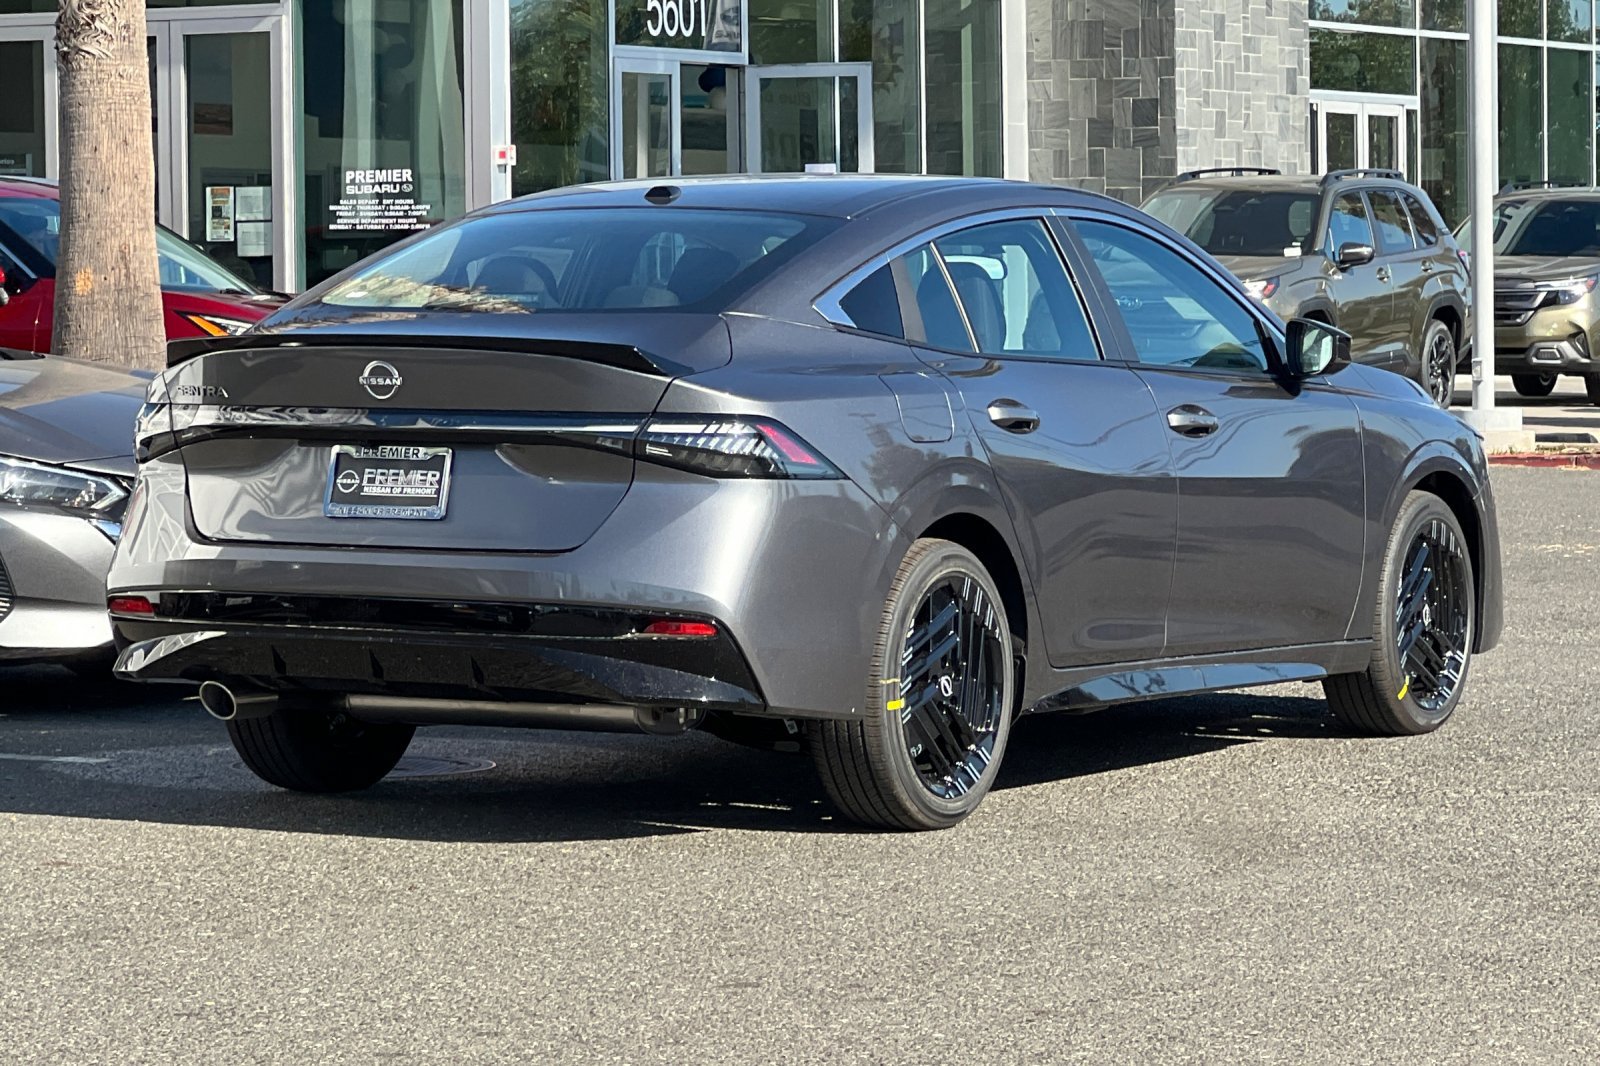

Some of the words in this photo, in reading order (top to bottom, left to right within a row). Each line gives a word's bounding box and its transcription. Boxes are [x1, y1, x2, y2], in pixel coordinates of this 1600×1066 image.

[646, 0, 706, 37] 5601
[345, 169, 413, 184] PREMIER
[345, 183, 400, 194] SUBARU
[358, 376, 402, 386] NISSAN
[176, 385, 229, 398] SENTRA
[361, 446, 420, 459] PREMIER
[362, 468, 440, 488] PREMIER
[403, 487, 437, 495] FREMONT
